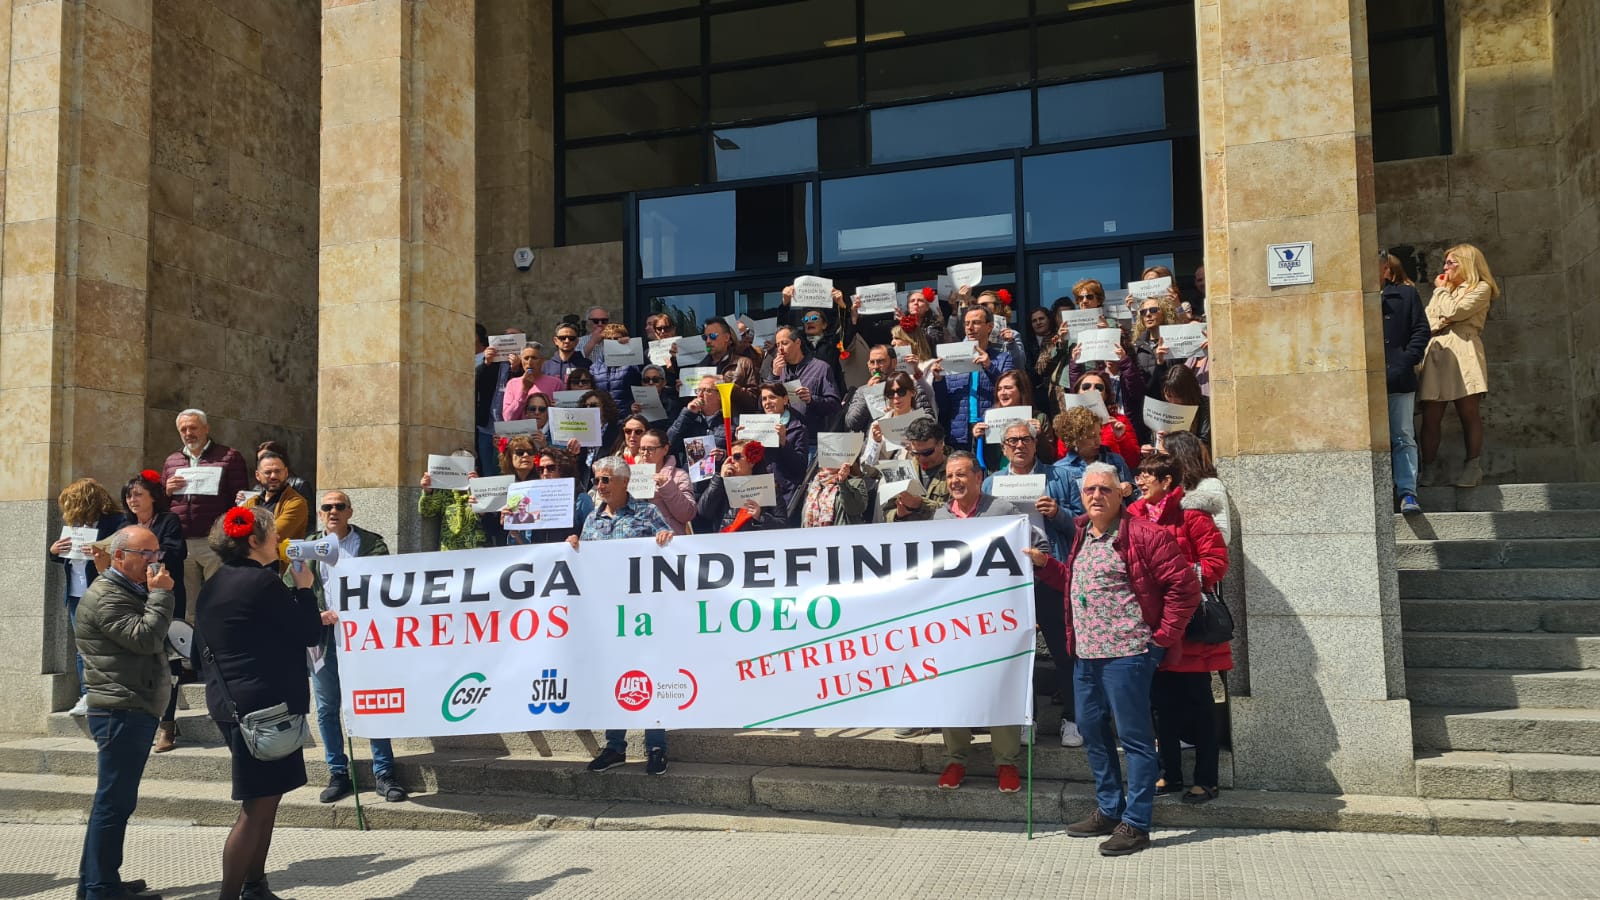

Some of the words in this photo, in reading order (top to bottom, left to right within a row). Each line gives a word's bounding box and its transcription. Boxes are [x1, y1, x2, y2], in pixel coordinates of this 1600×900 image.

[339, 560, 581, 612] HUELGA
[628, 535, 1024, 595] INDEFINIDA
[342, 605, 569, 652] PAREMOS
[616, 605, 653, 638] la
[697, 595, 842, 634] LOEO
[737, 608, 1019, 682] RETRIBUCIONES
[532, 678, 568, 701] STAJ
[620, 676, 648, 693] UGT
[657, 682, 688, 690] Servicios
[816, 657, 939, 700] JUSTAS
[354, 690, 404, 712] CCOO
[452, 687, 491, 705] CSIF
[656, 691, 685, 699] Públicos
